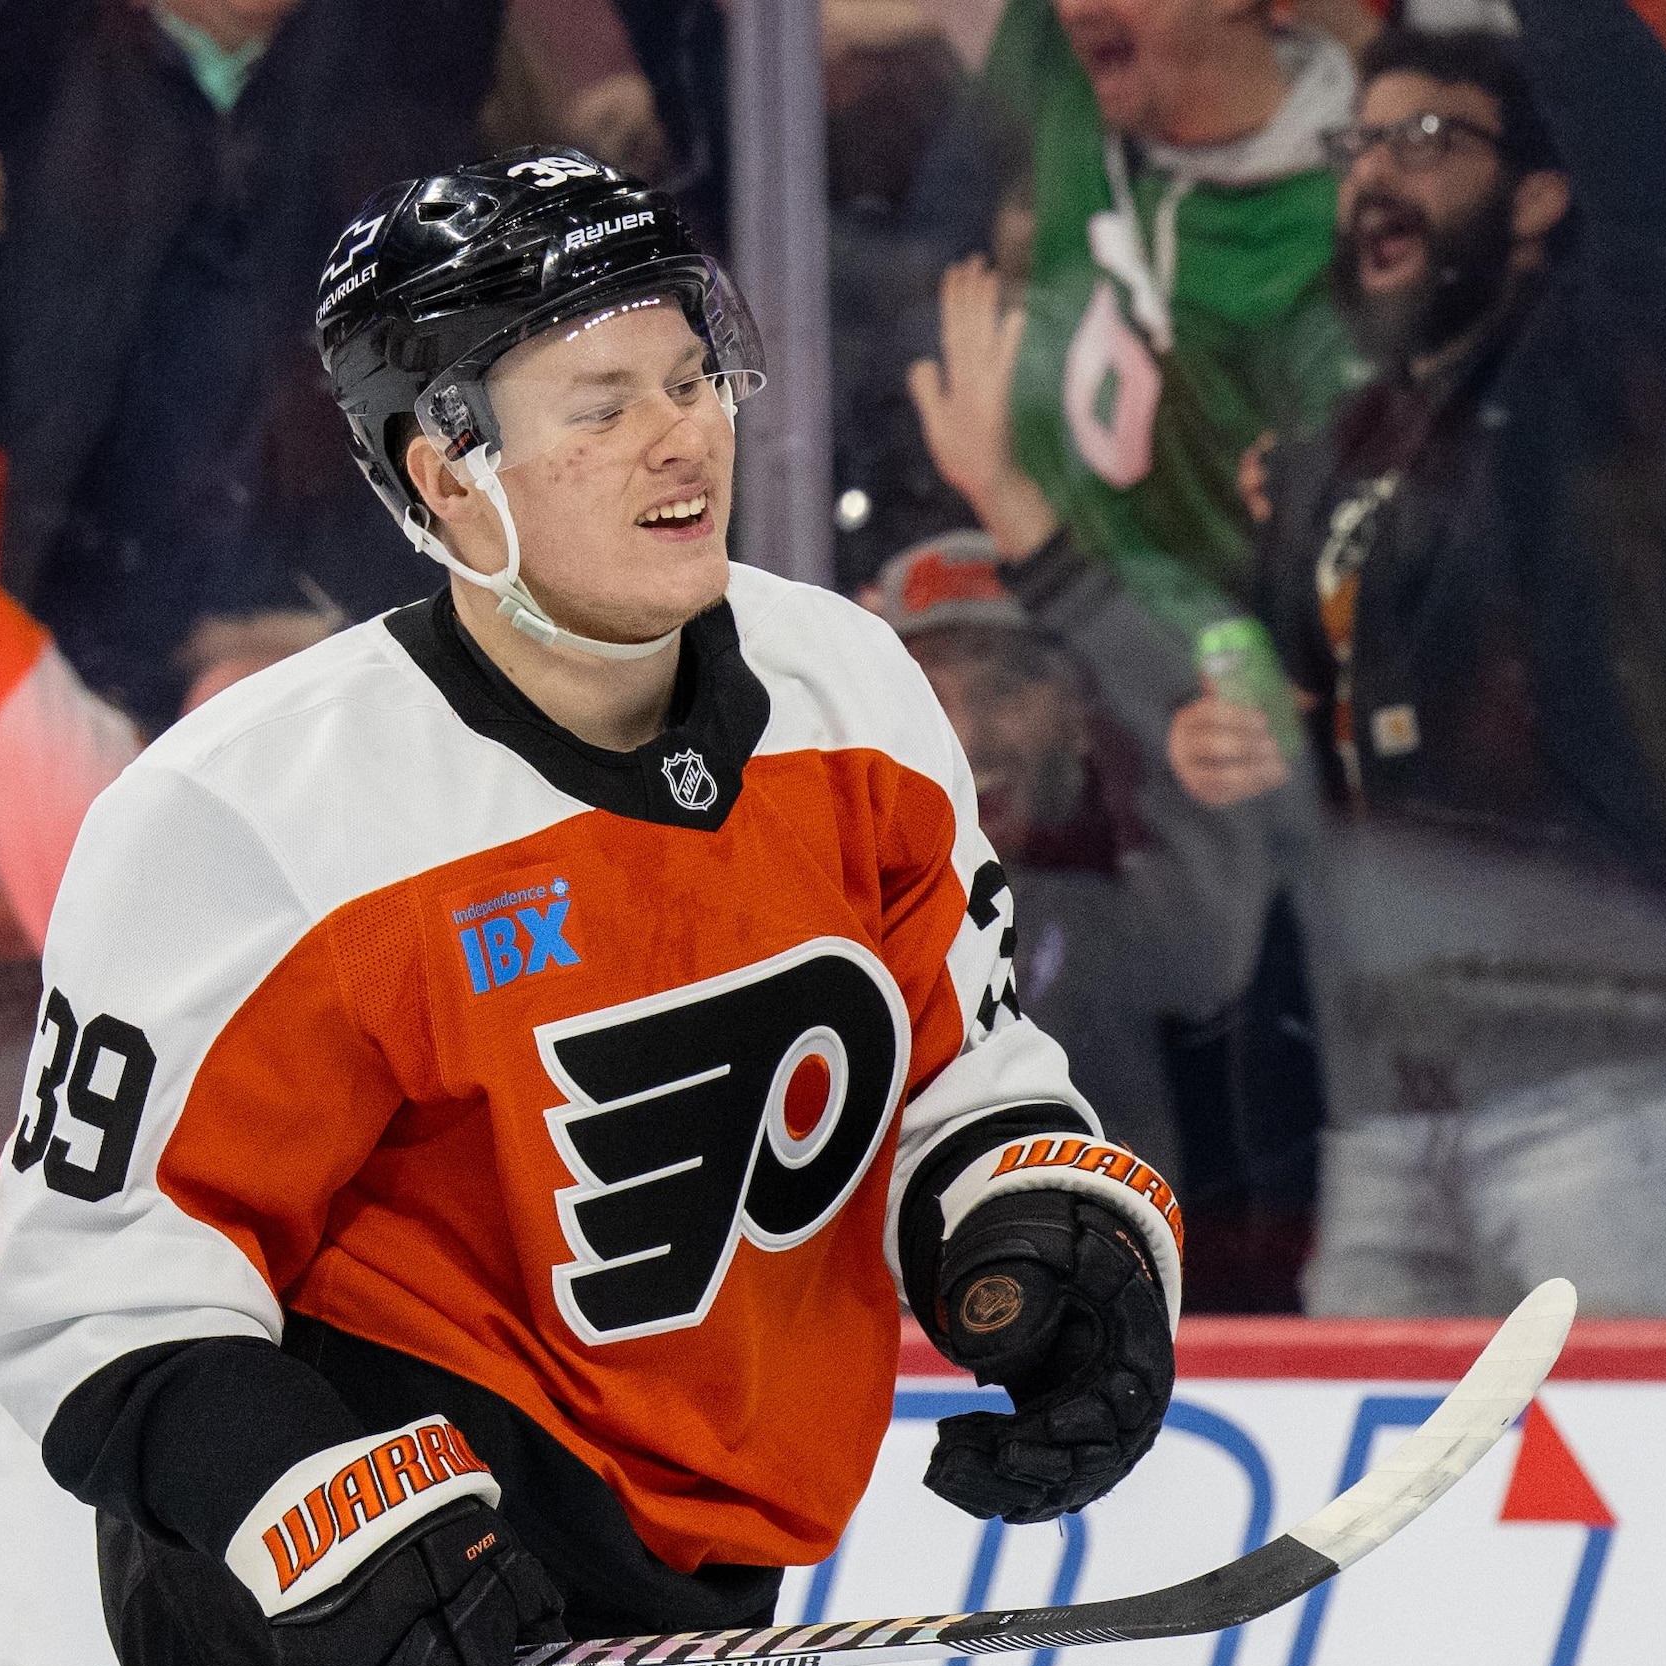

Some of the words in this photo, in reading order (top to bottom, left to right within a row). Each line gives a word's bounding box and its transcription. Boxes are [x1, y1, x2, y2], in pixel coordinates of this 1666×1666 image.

[507, 156, 602, 187] 39
[316, 261, 379, 325] CHEVROLET
[451, 885, 547, 925] Independence
[459, 899, 582, 995] IBX
[11, 986, 157, 1203] 39
